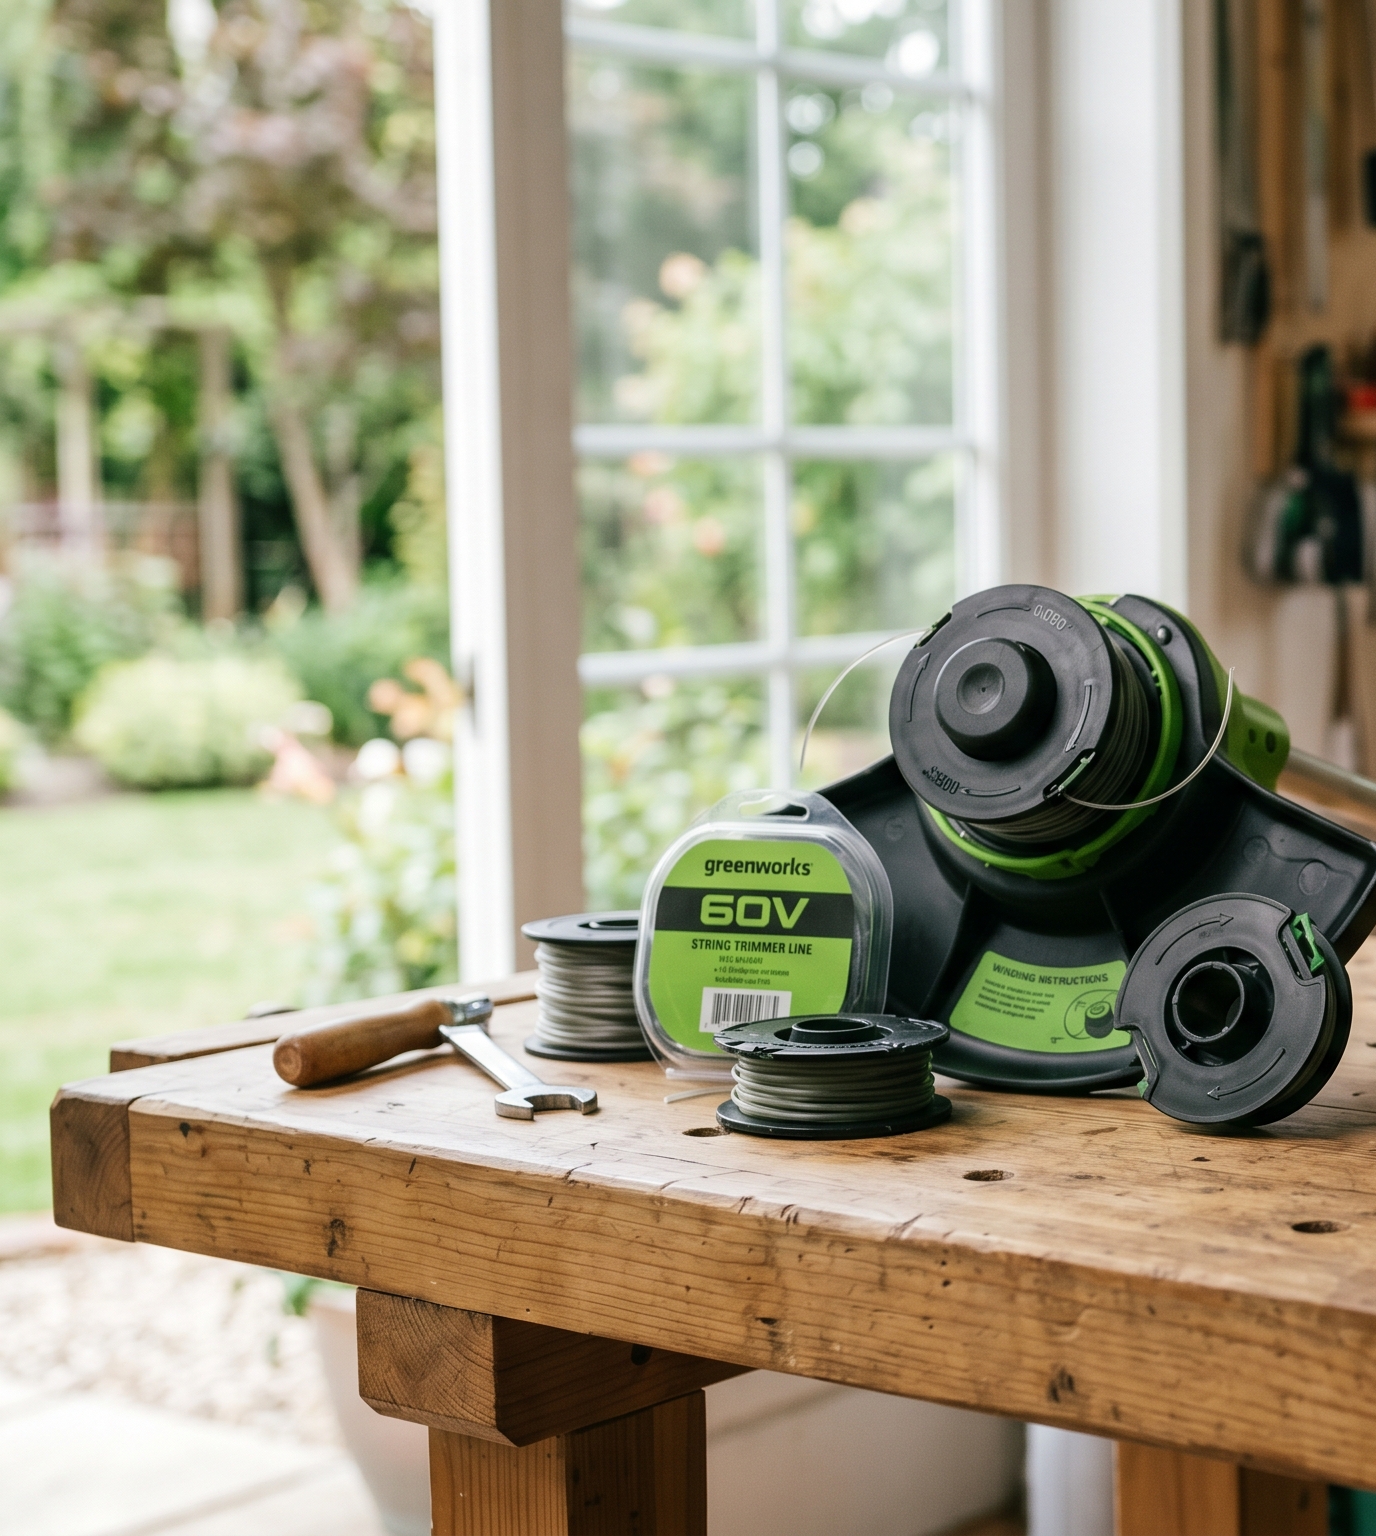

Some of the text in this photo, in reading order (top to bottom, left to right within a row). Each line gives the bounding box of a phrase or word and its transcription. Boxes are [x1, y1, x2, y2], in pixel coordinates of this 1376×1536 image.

[704, 857, 812, 877] greenworks
[700, 894, 810, 929] 60V
[691, 938, 813, 955] STRING TRIMMER LINE
